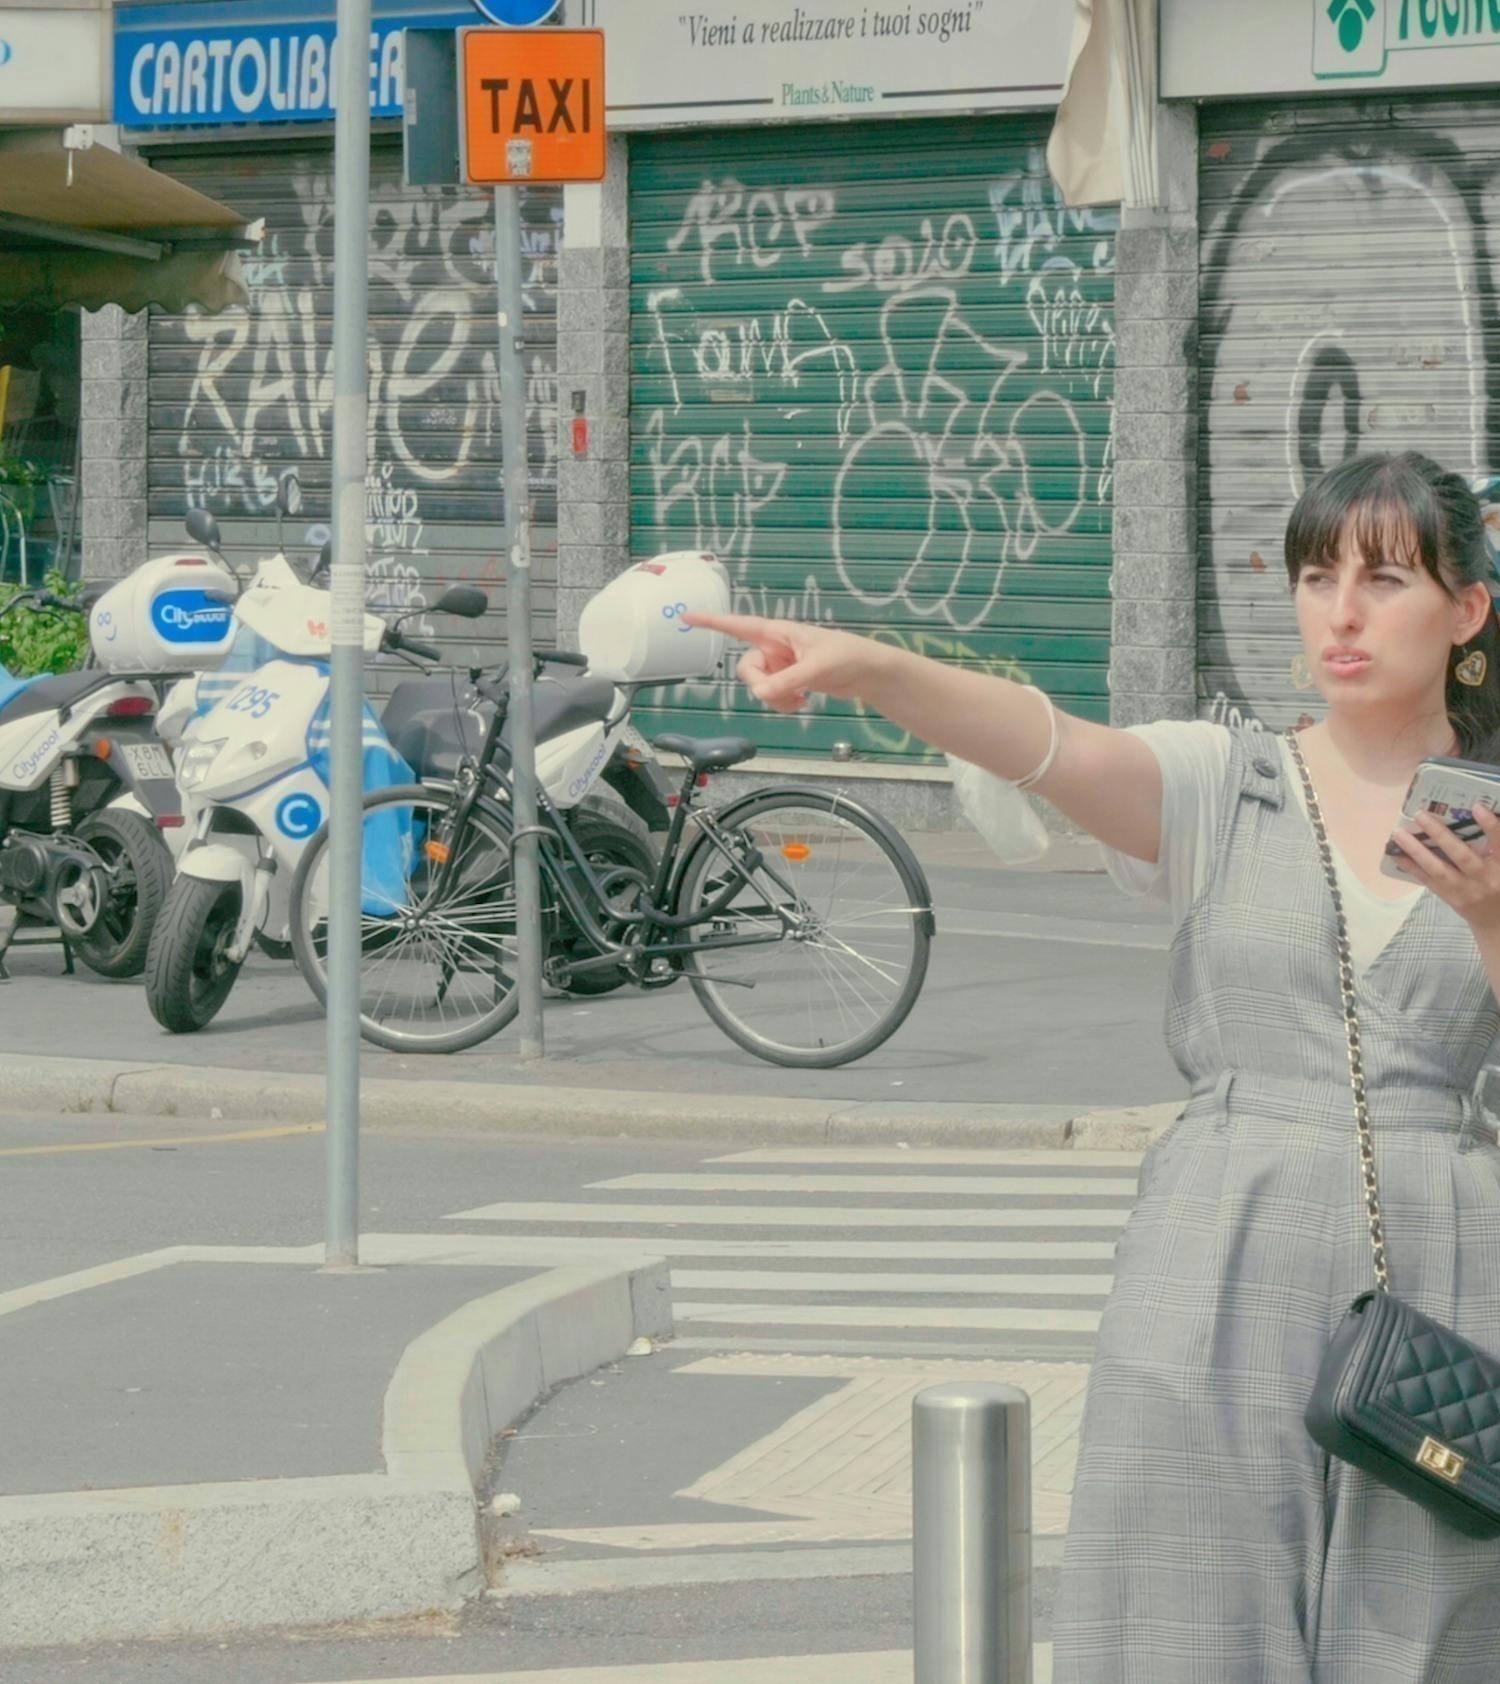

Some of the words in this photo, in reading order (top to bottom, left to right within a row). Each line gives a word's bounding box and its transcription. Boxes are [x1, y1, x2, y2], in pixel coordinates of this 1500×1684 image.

[742, 23, 755, 44] a
[761, 8, 854, 43] realizzare
[860, 8, 868, 37] i
[873, 5, 911, 37] tuoi
[480, 78, 591, 135] TAXI
